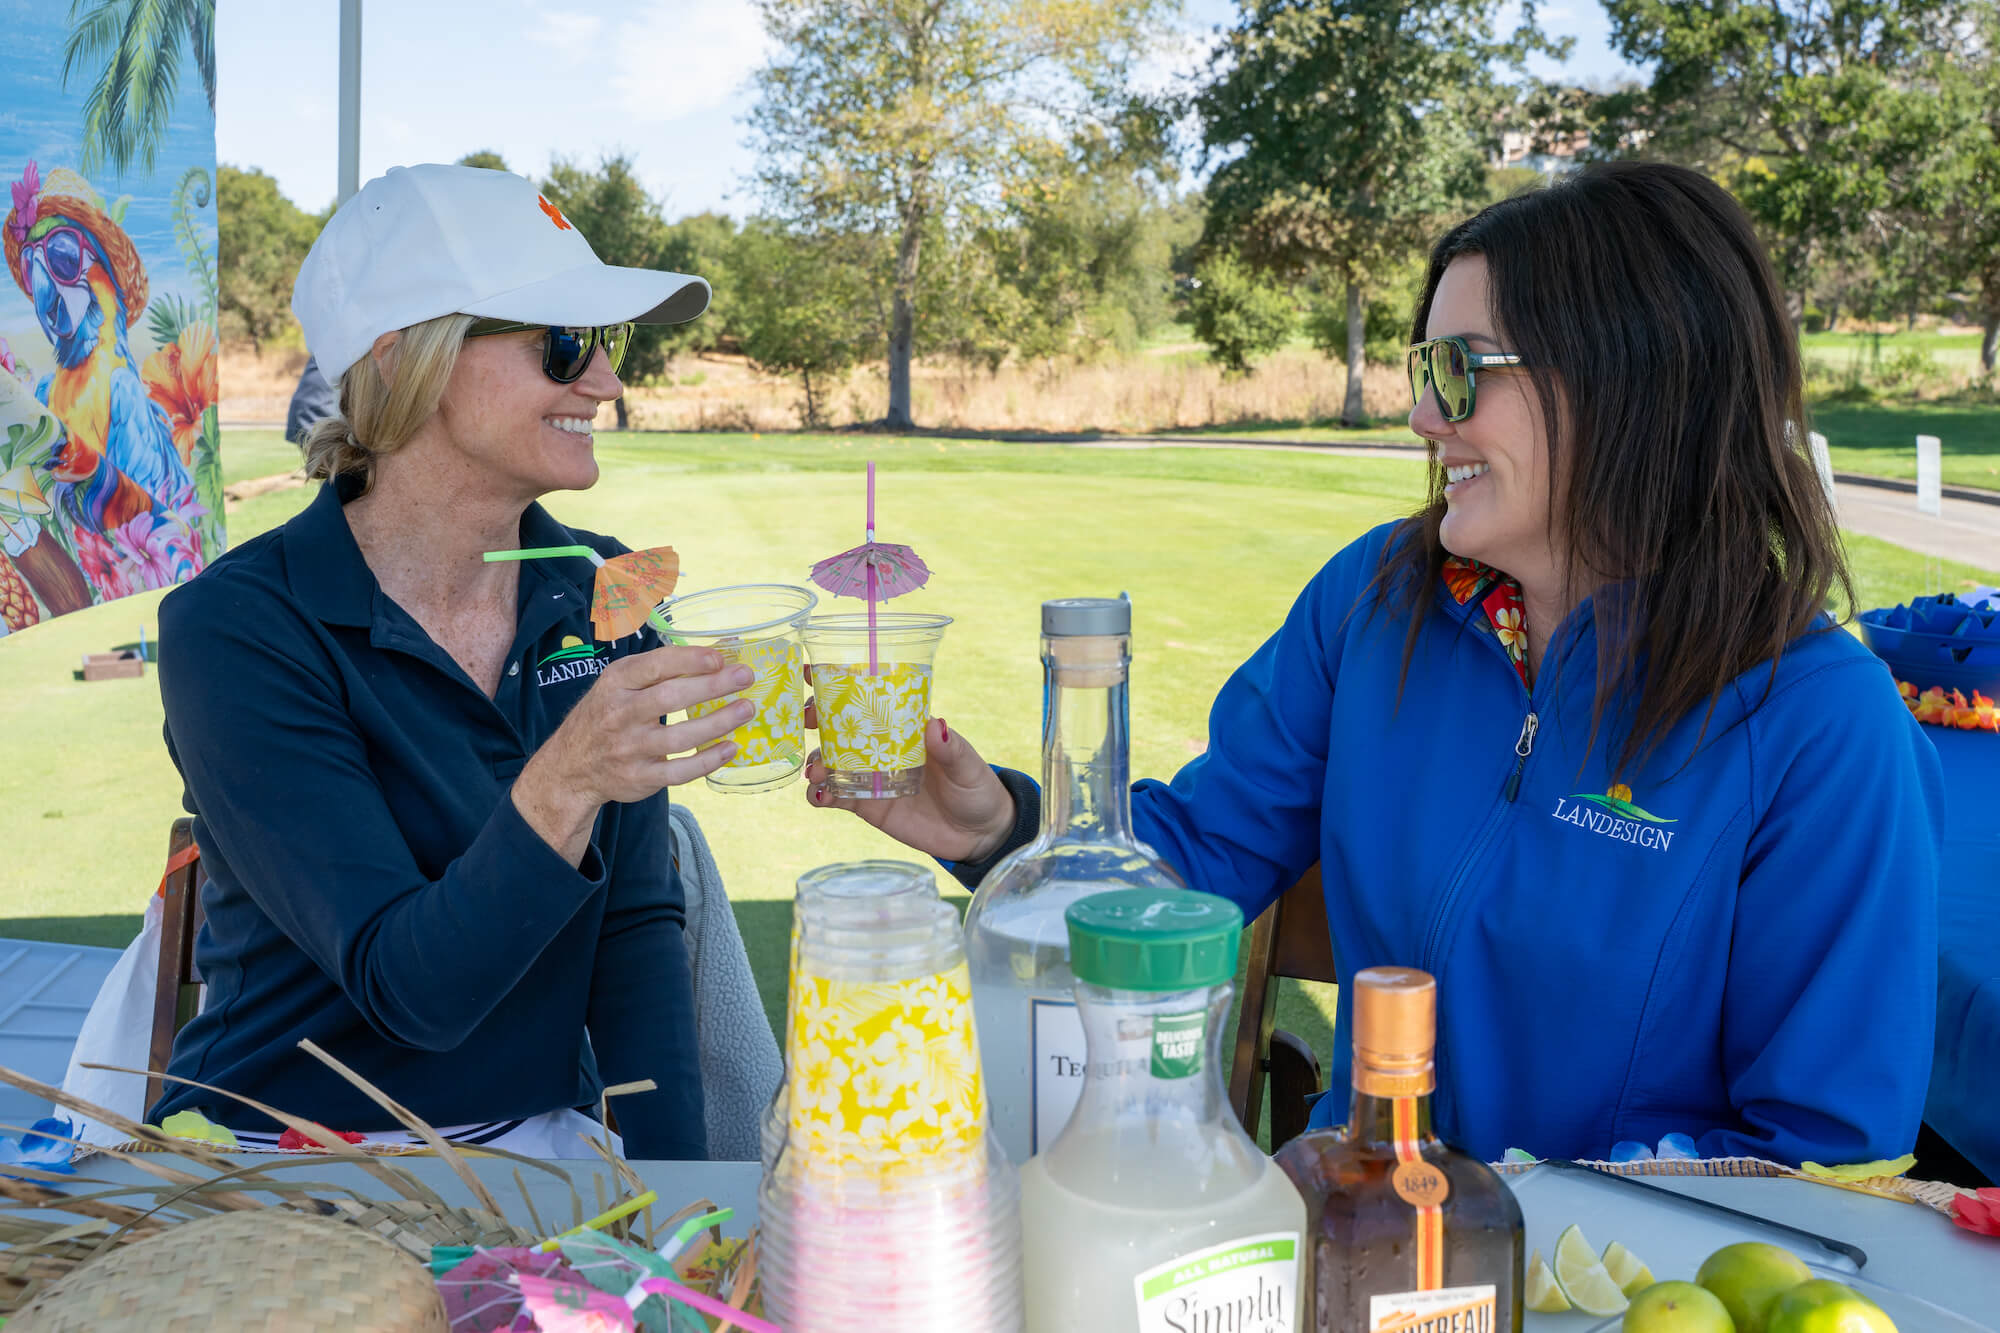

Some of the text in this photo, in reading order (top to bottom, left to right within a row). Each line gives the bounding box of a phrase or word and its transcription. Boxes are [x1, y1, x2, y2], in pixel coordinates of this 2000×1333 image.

[1552, 798, 1674, 852] LANDESIGN
[1162, 1040, 1196, 1059] TASTE
[1404, 1175, 1438, 1193] 1849
[1173, 1246, 1275, 1284] ALL NATURAL
[1164, 1276, 1285, 1333] Simply
